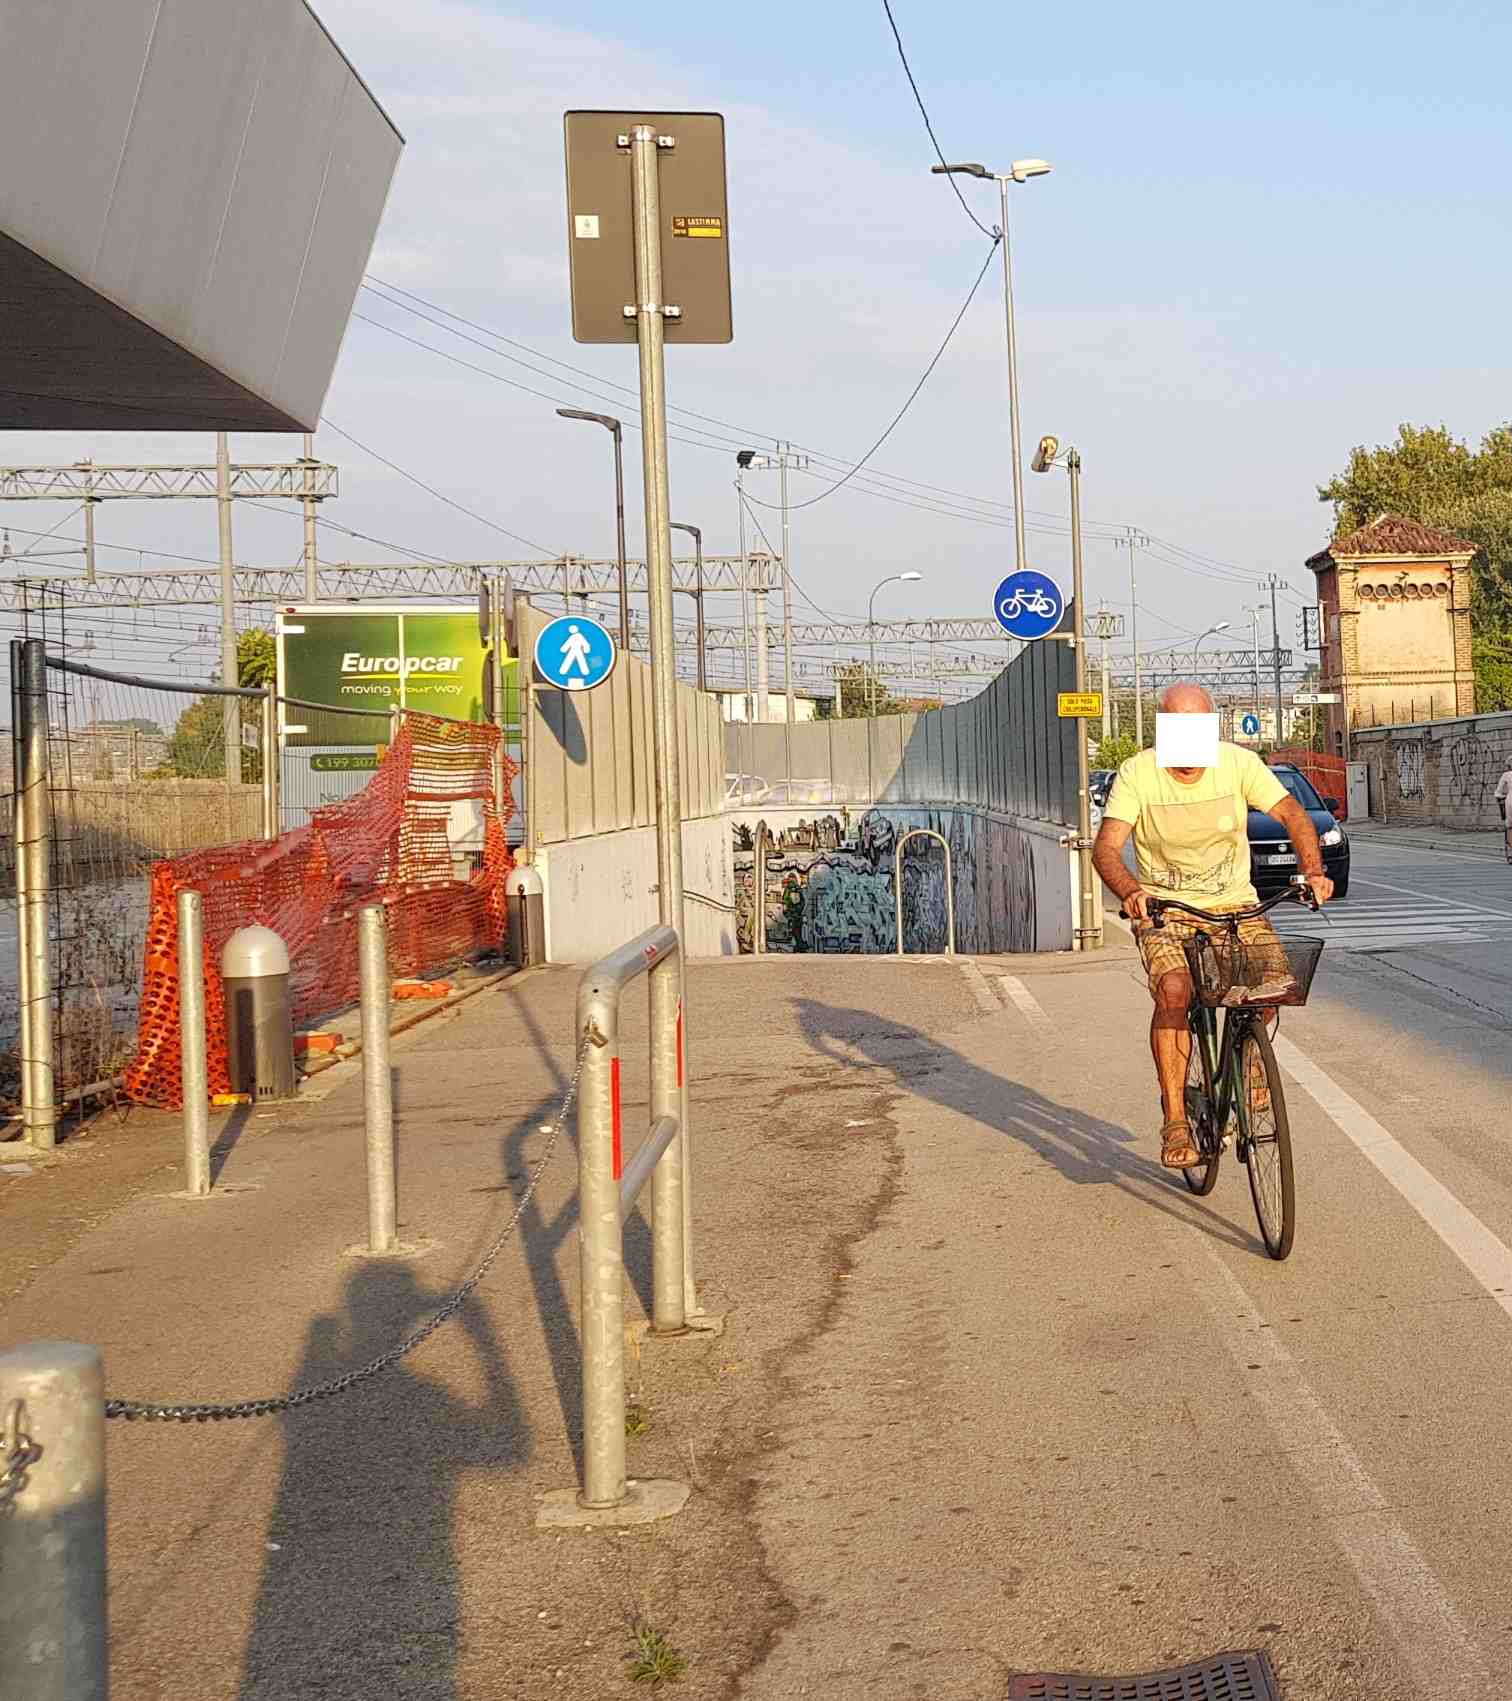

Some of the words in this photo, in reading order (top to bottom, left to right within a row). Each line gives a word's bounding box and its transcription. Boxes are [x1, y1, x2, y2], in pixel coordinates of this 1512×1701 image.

[341, 653, 464, 677] Europcar
[340, 683, 392, 696] moving
[434, 684, 464, 696] way
[328, 757, 349, 768] 199
